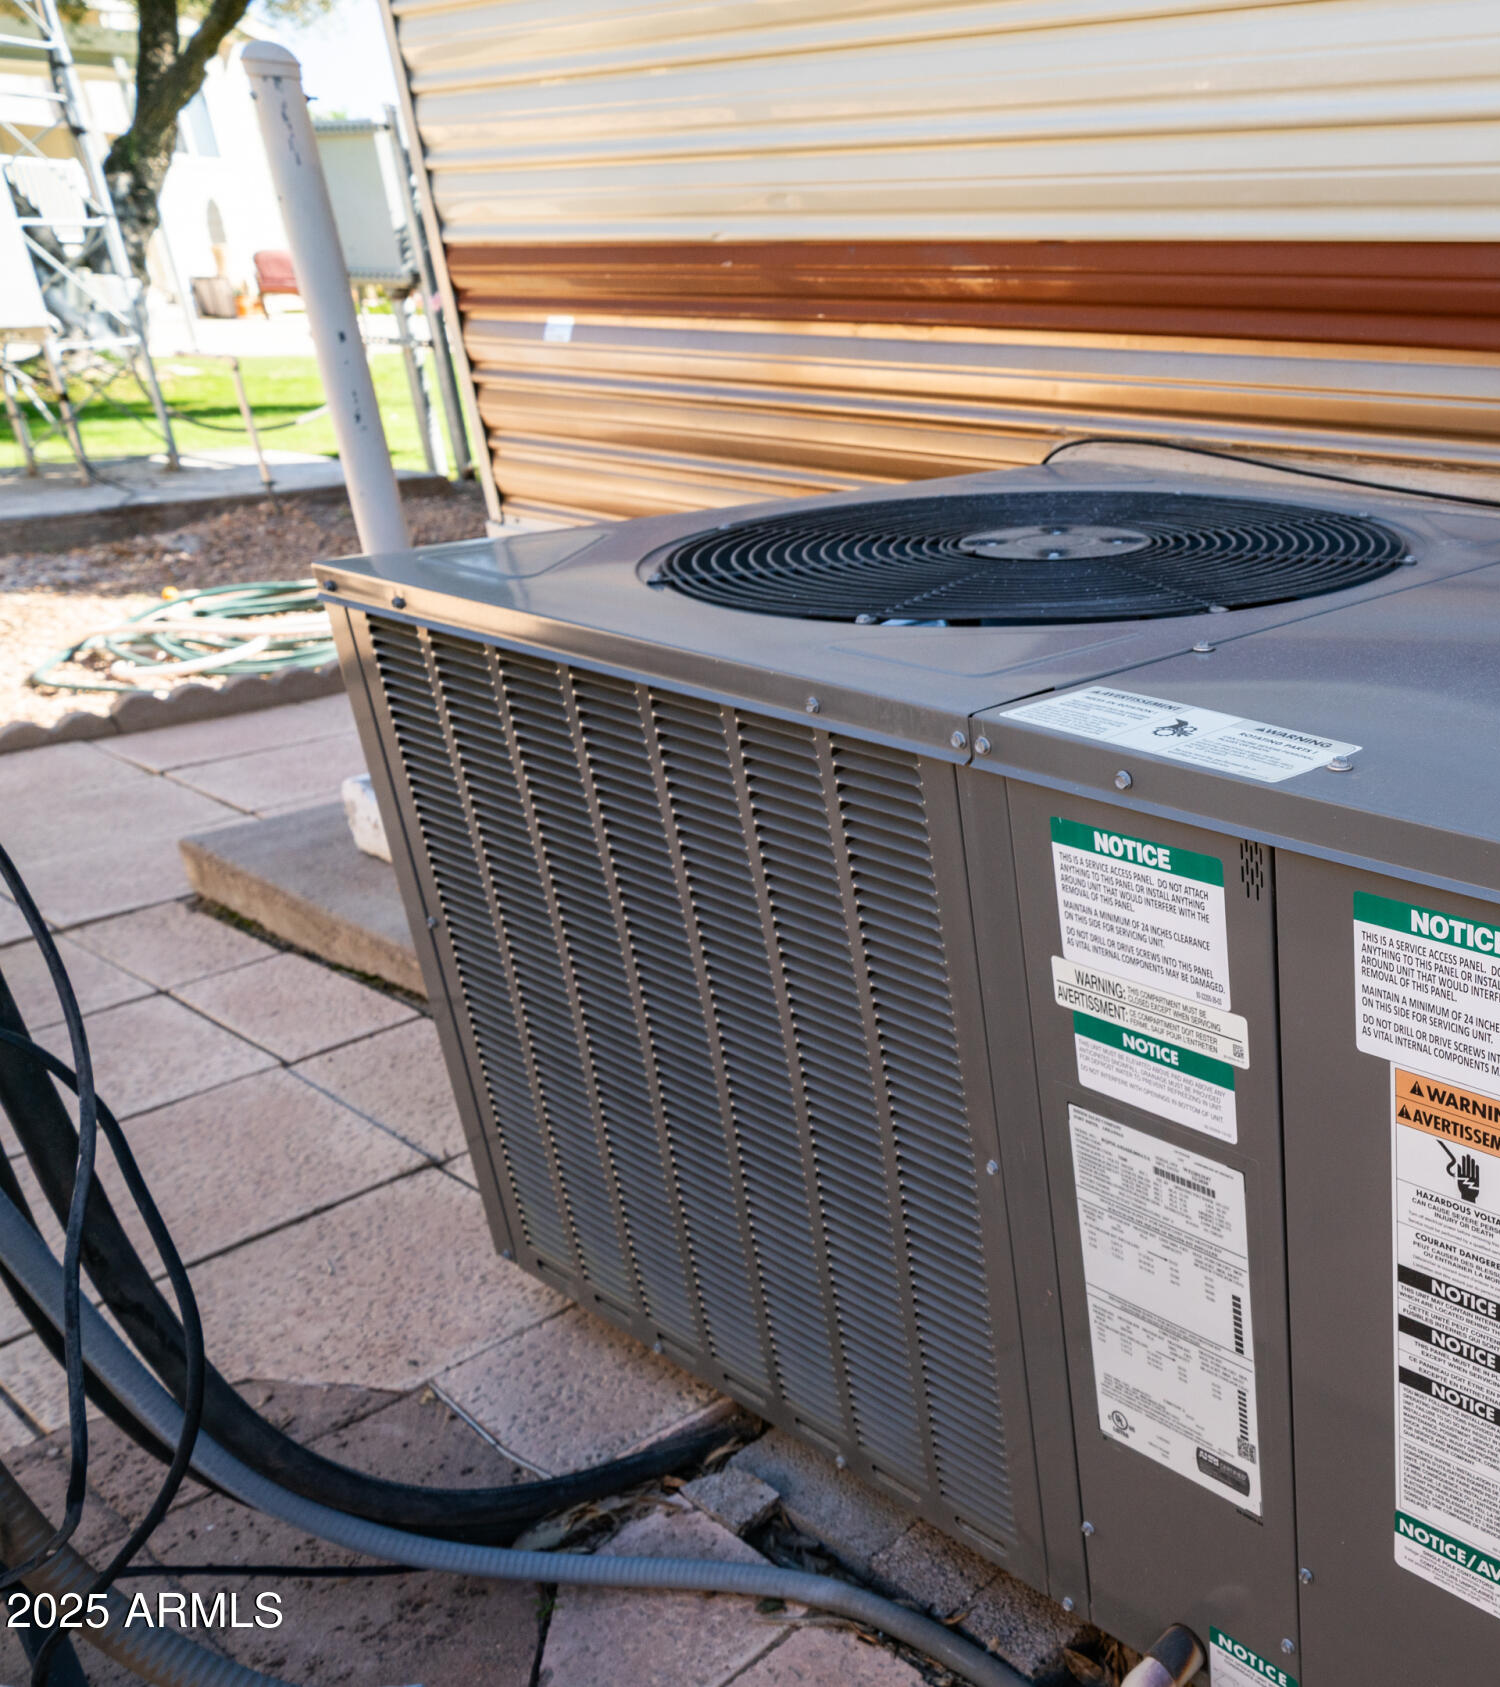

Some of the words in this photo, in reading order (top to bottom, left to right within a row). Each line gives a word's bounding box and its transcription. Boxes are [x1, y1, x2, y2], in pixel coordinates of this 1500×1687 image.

[1266, 728, 1333, 748] WARNING
[1093, 831, 1171, 870] NOTICE
[1059, 851, 1072, 863] THIS
[1073, 855, 1078, 865] IS
[1079, 857, 1084, 867] A
[1084, 858, 1108, 873] SERVICE
[1110, 865, 1132, 880] ACCESS
[1133, 871, 1154, 886] PANEL.
[1157, 878, 1167, 889] DO
[1168, 881, 1182, 893] NOT
[1183, 885, 1208, 900] ATTACH
[1059, 862, 1090, 879] ANYTHING
[1090, 871, 1099, 882] TO
[1100, 873, 1114, 886] THIS
[1115, 877, 1134, 891] PANEL
[1135, 883, 1144, 894] OR
[1146, 886, 1170, 901] INSTALL
[1171, 893, 1205, 911] ANYTHING
[1060, 873, 1086, 888] AROUND
[1087, 880, 1101, 893] UNIT
[1102, 884, 1118, 897] THAT
[1119, 889, 1143, 904] WOULD
[1143, 896, 1177, 914] INTERFERE
[1178, 905, 1195, 919] WITH
[1196, 910, 1209, 923] THE
[1061, 883, 1089, 899] REMOVAL
[1090, 891, 1098, 902] OF
[1099, 894, 1113, 906] THIS
[1114, 898, 1135, 912] PANEL.
[1065, 936, 1073, 947] AS
[1074, 939, 1090, 952] VITAL
[1091, 944, 1120, 961] INTERNAL
[1120, 953, 1164, 975] COMPONENTS
[1165, 966, 1179, 979] MAY
[1180, 971, 1188, 982] BE
[1189, 974, 1225, 993] DAMAGED.
[1361, 942, 1400, 963] ANYTHING
[1402, 953, 1413, 966] TO
[1415, 957, 1432, 971] THIS
[1434, 962, 1458, 978] PANEL
[1460, 969, 1472, 982] OR
[1362, 930, 1378, 944] THIS
[1380, 935, 1386, 946] IS
[1388, 937, 1393, 948] A
[1395, 939, 1426, 957] SERVICE
[1428, 948, 1457, 965] ACCESS
[1459, 956, 1486, 973] PANEL.
[1074, 968, 1126, 1000] WARNING:
[1361, 954, 1394, 973] AROUND
[1396, 964, 1414, 979] UNIT
[1416, 969, 1436, 985] THAT
[1438, 975, 1468, 994] WOULD
[1361, 966, 1397, 985] REMOVAL
[1399, 976, 1409, 989] OF
[1411, 980, 1428, 994] THIS
[1430, 985, 1457, 1002] PANEL.
[1056, 984, 1128, 1023] AVERTISSMENT:
[1126, 985, 1139, 996] THIS
[1140, 989, 1180, 1010] COMPARTMENT
[1181, 1003, 1198, 1016] MUST
[1199, 1009, 1206, 1018] BE
[1361, 983, 1399, 1004] MAINTAIN
[1401, 995, 1407, 1006] A
[1409, 997, 1448, 1019] MINIMUM
[1451, 1009, 1462, 1022] OF
[1464, 1013, 1473, 1026] 24
[1361, 996, 1373, 1008] ON
[1375, 1000, 1391, 1014] THIS
[1393, 1005, 1409, 1019] SIDE
[1411, 1010, 1426, 1024] FOR
[1428, 1015, 1469, 1037] SERVICING
[1471, 1028, 1493, 1044] UNIT.
[1122, 1033, 1179, 1066] NOTICE
[1362, 1013, 1374, 1026] DO
[1375, 1017, 1391, 1031] NOT
[1393, 1022, 1413, 1038] DRILL
[1415, 1029, 1426, 1042] OR
[1428, 1033, 1451, 1049] DRIVE
[1453, 1040, 1485, 1059] SCREWS
[1362, 1025, 1371, 1037] AS
[1373, 1028, 1393, 1044] VITAL
[1394, 1035, 1431, 1055] INTERNAL
[1433, 1046, 1489, 1073] COMPONENTS
[1412, 1197, 1426, 1207] CAN
[1427, 1202, 1449, 1216] CAUSE
[1451, 1211, 1478, 1226] SEVERE
[1416, 1189, 1471, 1215] HAZARDOUS
[1415, 1231, 1457, 1254] COURANT
[1434, 1211, 1457, 1225] INJURY
[1459, 1221, 1469, 1229] OR
[1471, 1225, 1493, 1238] DEATH
[1412, 1240, 1429, 1251] PEUT
[1431, 1247, 1458, 1262] CAUSER
[1460, 1258, 1473, 1268] DES
[1423, 1250, 1433, 1259] OU
[1474, 1270, 1483, 1278] LA
[1431, 1279, 1497, 1318] NOTICE
[1431, 1329, 1496, 1368] NOTICE
[1431, 1382, 1495, 1421] NOTICE
[1218, 1633, 1287, 1687] NOTICE
